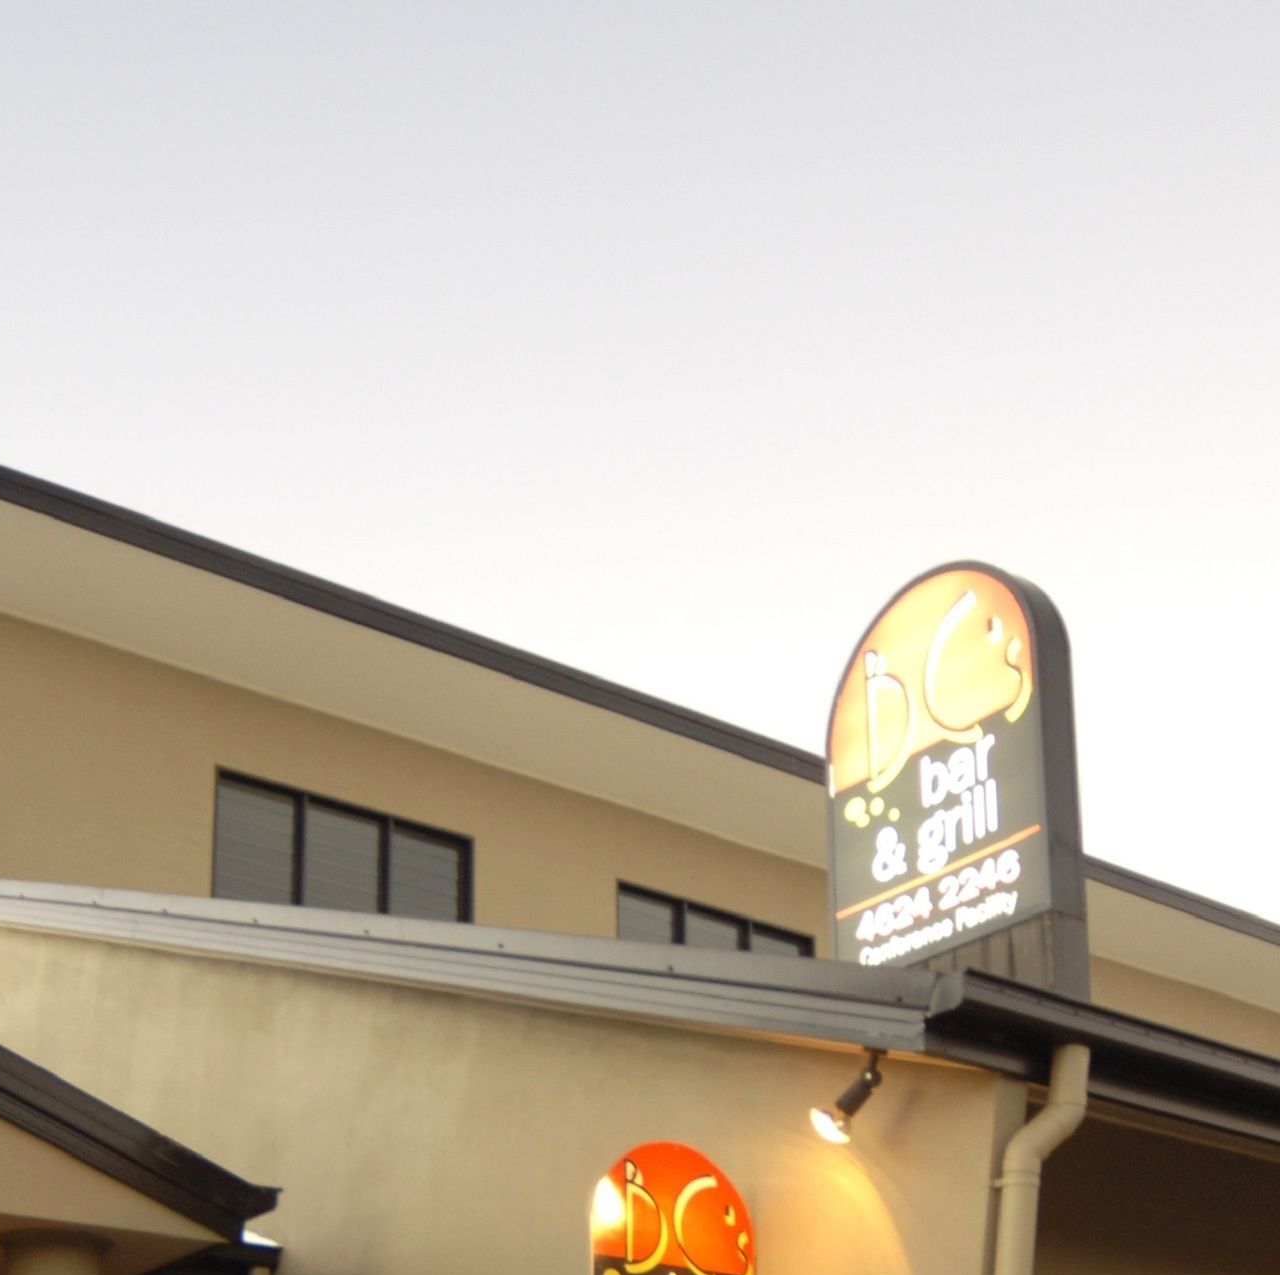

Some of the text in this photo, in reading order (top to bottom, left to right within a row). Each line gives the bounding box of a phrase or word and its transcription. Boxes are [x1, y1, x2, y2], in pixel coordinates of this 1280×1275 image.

[920, 734, 995, 808] bar
[871, 779, 999, 883] & grill
[938, 849, 1021, 911] 2246
